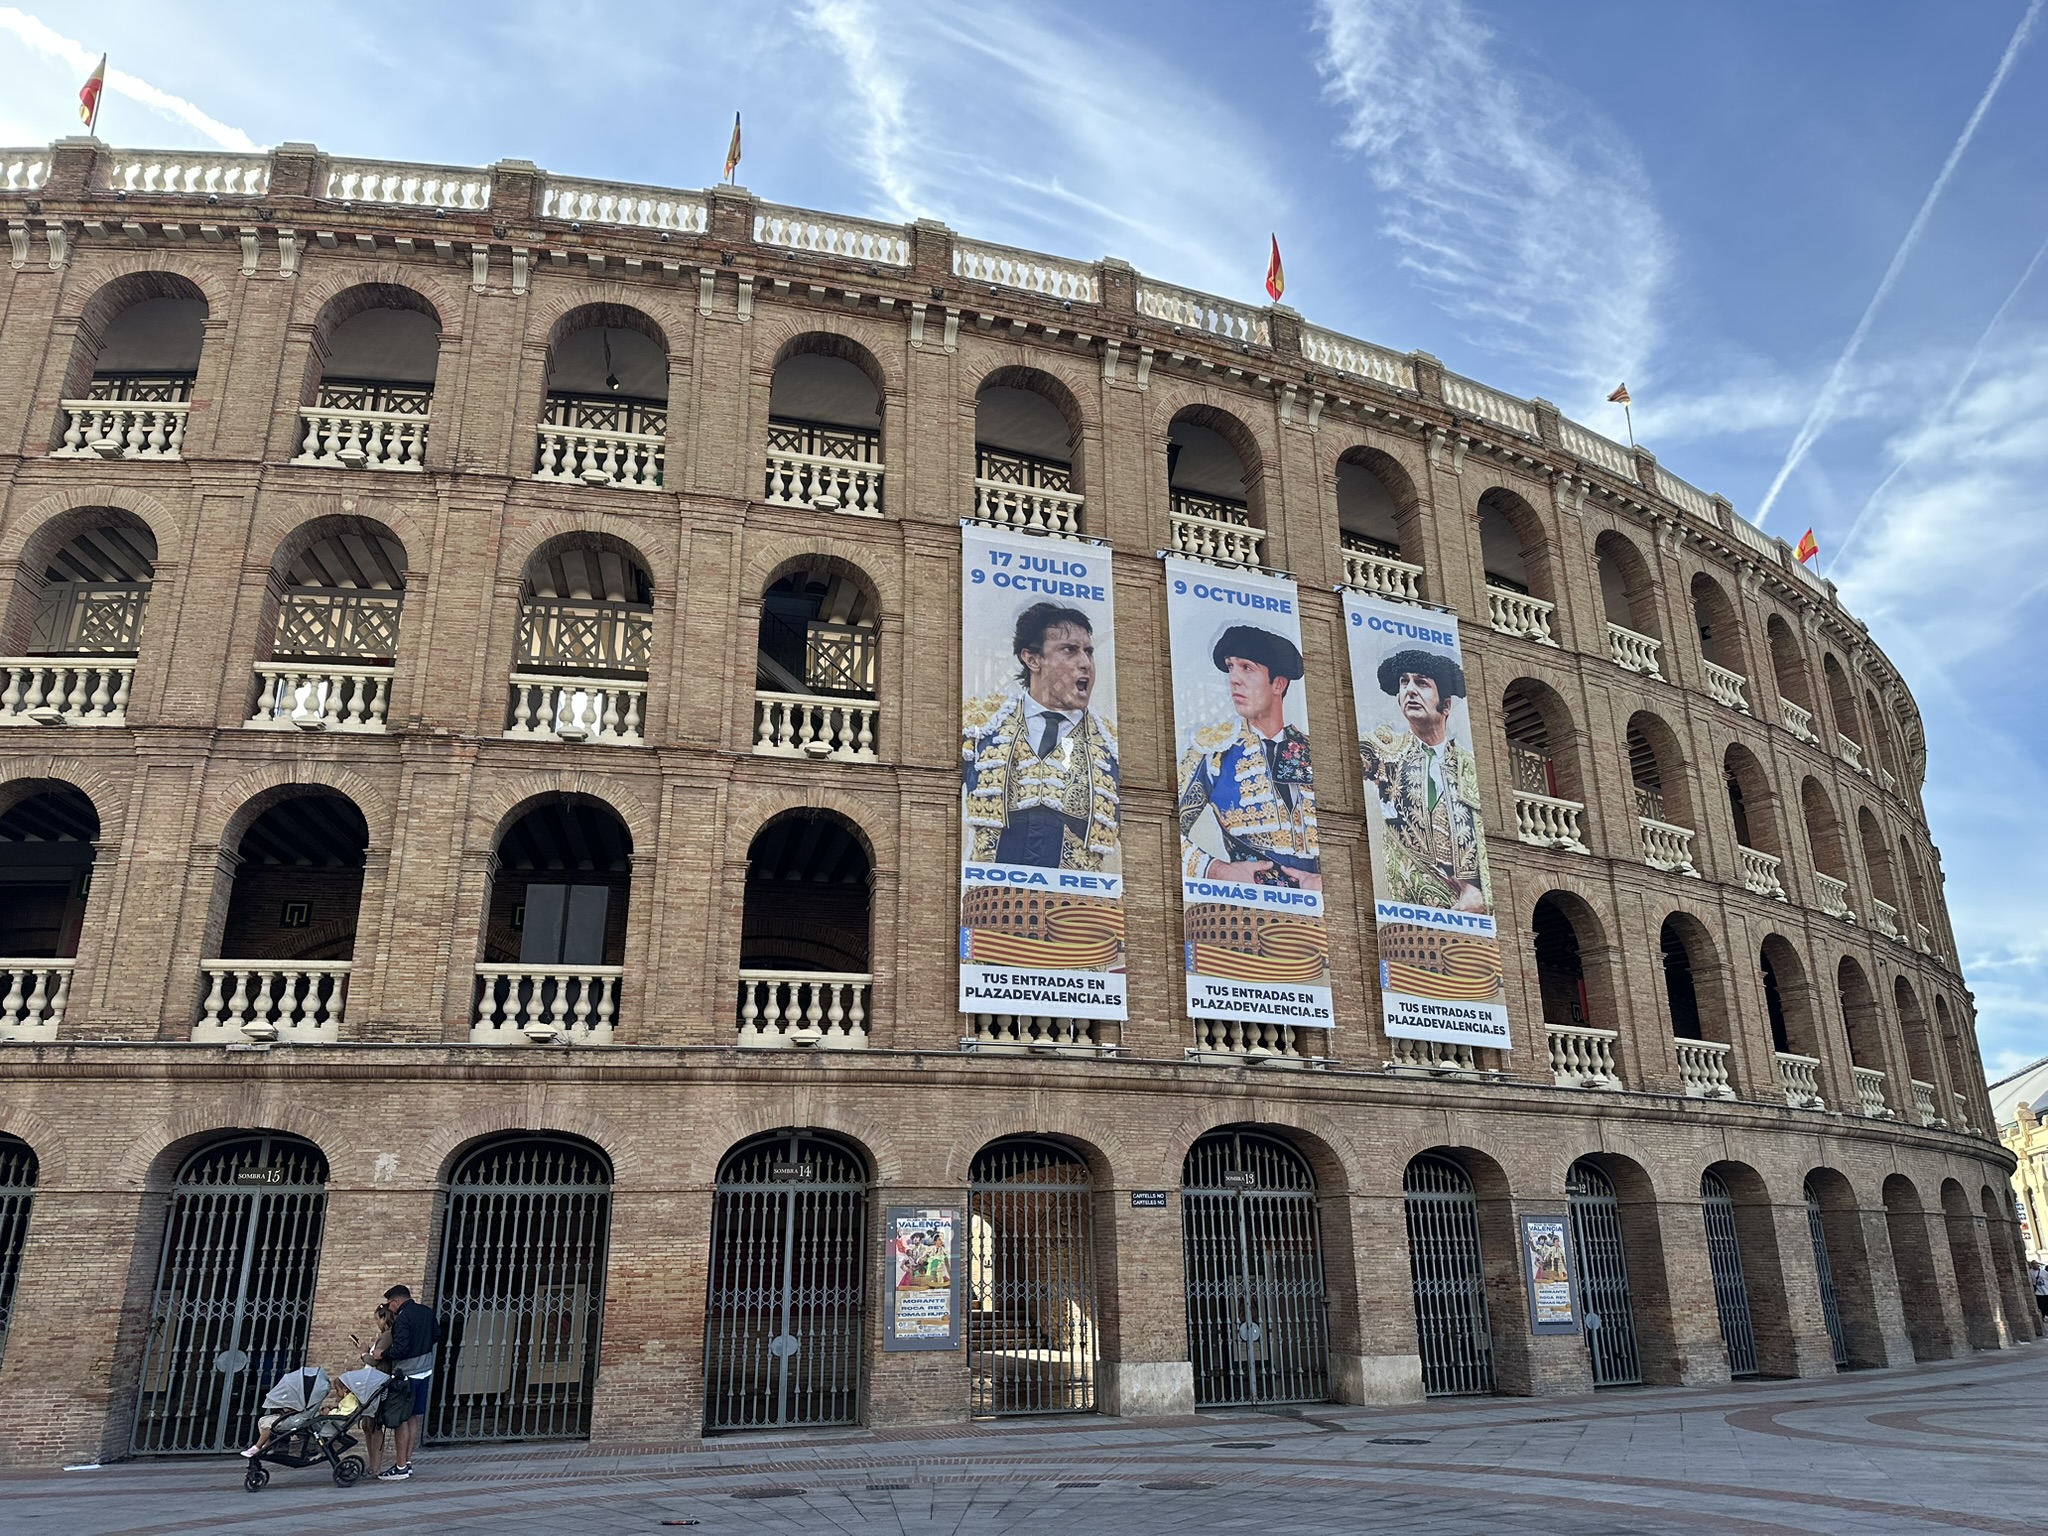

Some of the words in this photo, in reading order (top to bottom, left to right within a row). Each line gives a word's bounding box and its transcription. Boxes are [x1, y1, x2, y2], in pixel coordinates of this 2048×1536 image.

[988, 550, 1012, 567] 17
[1019, 555, 1087, 578] JULIO
[970, 569, 986, 584] 9
[992, 572, 1105, 601] OCTUBRE
[1174, 580, 1187, 595] 9
[1193, 584, 1292, 614] OCTUBRE
[1351, 612, 1363, 627] 9
[1367, 616, 1454, 647] OCTUBRE
[965, 867, 1049, 885] ROCA
[1059, 874, 1118, 890] REY
[1184, 882, 1258, 900] TOMÁS
[1263, 890, 1317, 907] RUFO
[1377, 904, 1492, 930] MORANTE
[982, 973, 1008, 984] TUS
[1011, 974, 1084, 989] ENTRADAS
[1087, 979, 1105, 990] EN
[965, 986, 1122, 1006] PLAZADEVALENCIA.ES
[1205, 985, 1229, 997] TUS
[1232, 987, 1296, 1002] ENTRADAS
[1298, 992, 1314, 1004] EN
[1191, 997, 1330, 1019] PLAZADEVALENCIA.ES
[1399, 1002, 1419, 1013] TUS
[1421, 1004, 1477, 1020] ENTRADAS
[1478, 1011, 1492, 1021] EN
[1387, 1014, 1506, 1035] PLAZADEVALENCIA.ES
[266, 1169, 281, 1183] 15
[799, 1165, 812, 1177] 14
[1245, 1173, 1254, 1184] 13
